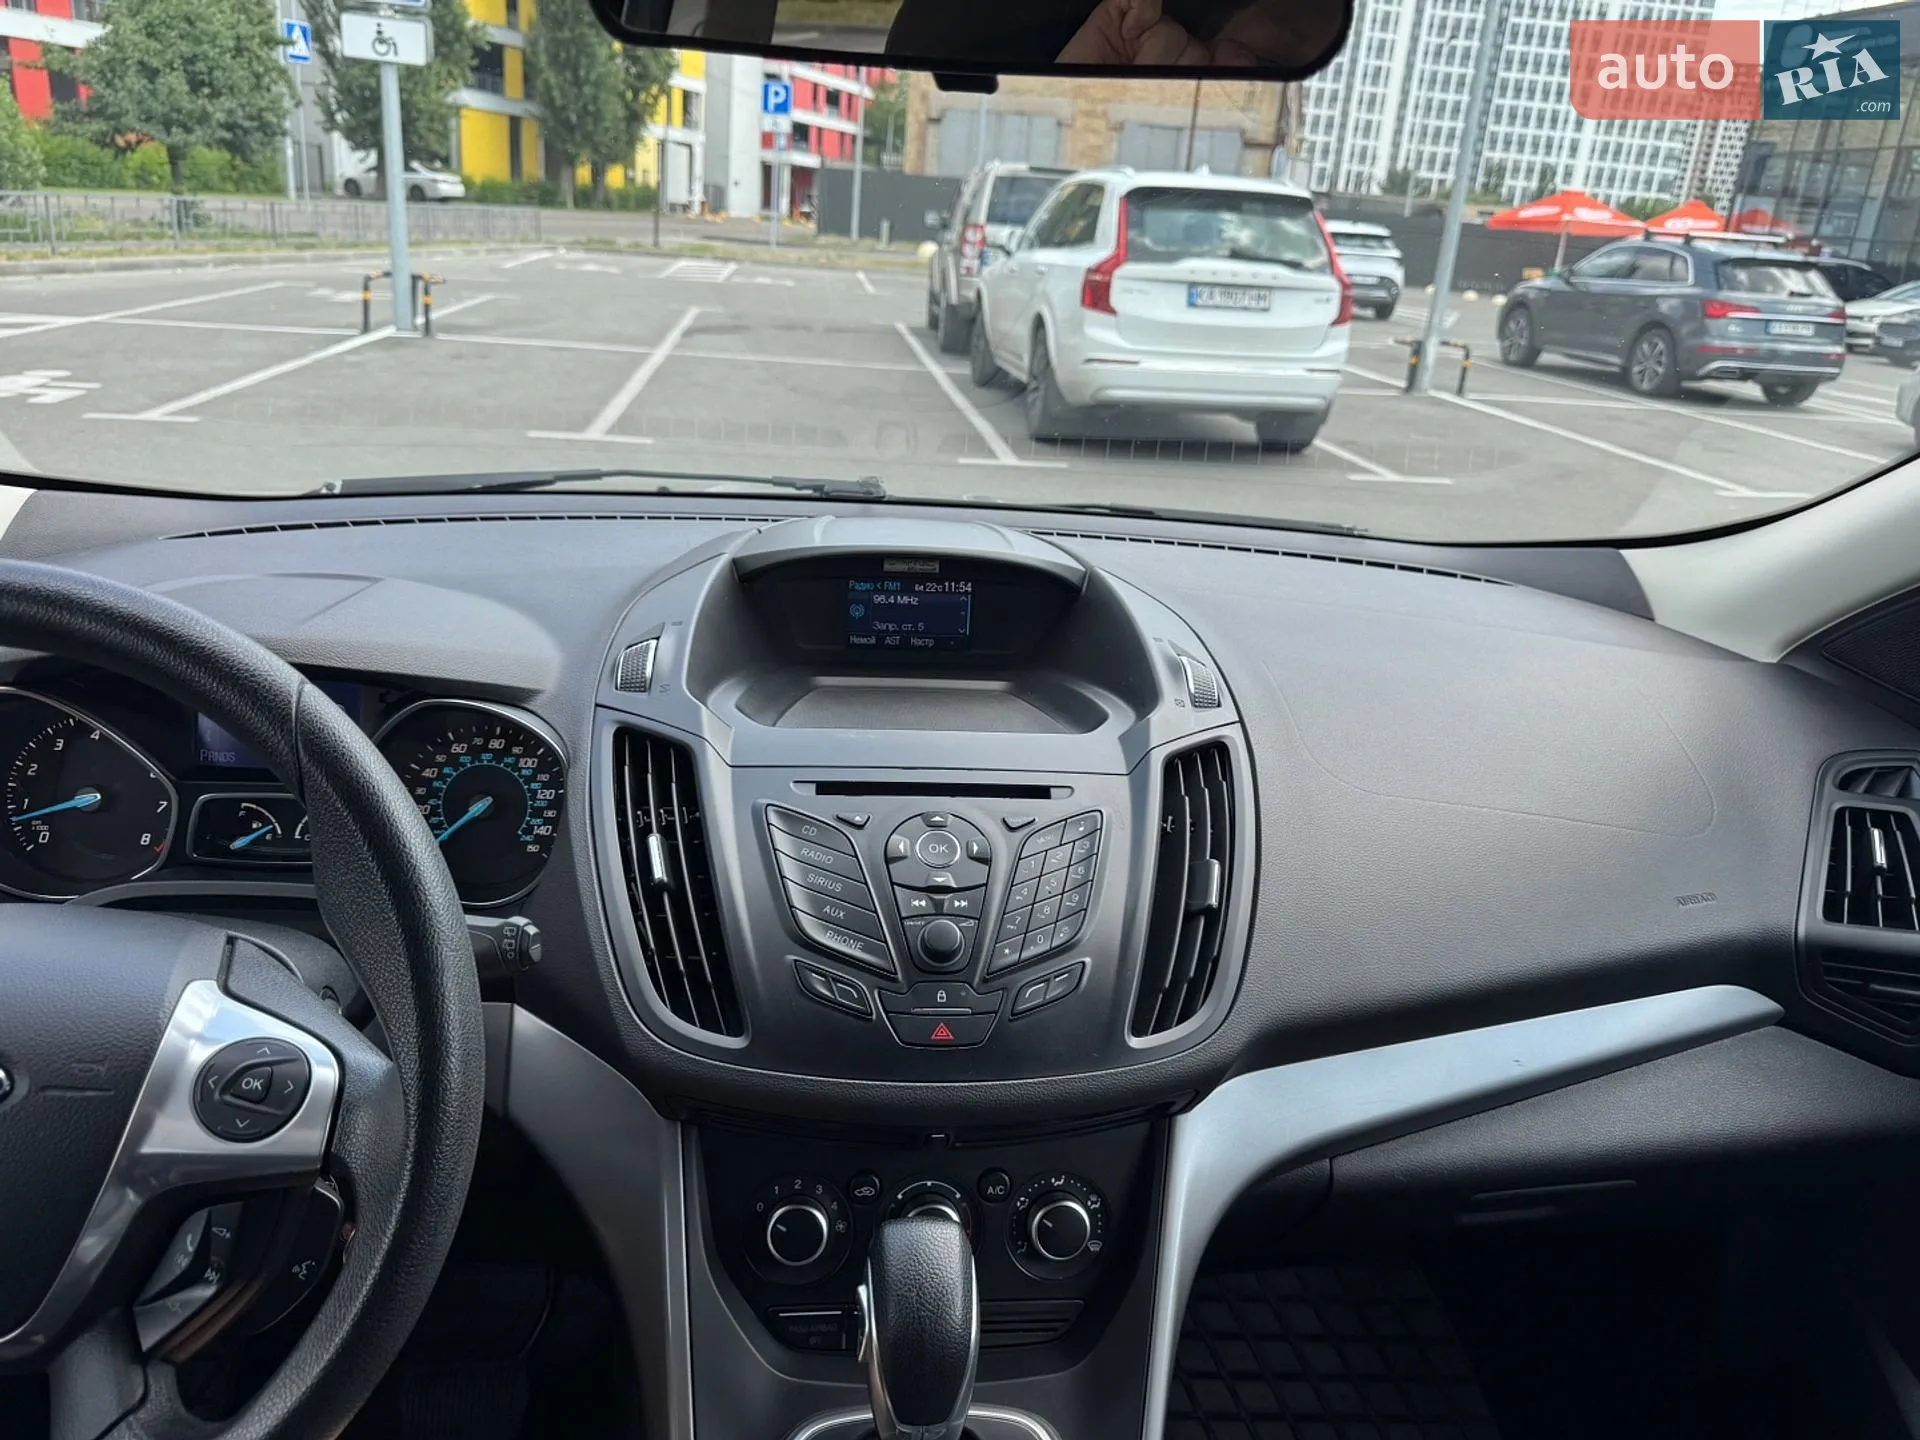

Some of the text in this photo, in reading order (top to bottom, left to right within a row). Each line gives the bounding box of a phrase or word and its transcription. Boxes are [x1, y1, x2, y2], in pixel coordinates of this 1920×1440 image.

[767, 85, 787, 113] P
[883, 581, 901, 591] FM1
[943, 581, 973, 593] 11:54
[872, 594, 920, 606] 96.4 MHz
[884, 635, 902, 646] AST
[89, 729, 101, 740] 4
[53, 738, 64, 751] 3
[450, 743, 468, 754] 60
[488, 738, 506, 750] 80
[434, 754, 447, 763] 50
[518, 757, 538, 769] 100
[27, 763, 38, 777] 2
[421, 767, 438, 778] 40
[535, 789, 555, 800] 120
[22, 798, 30, 811] 1
[156, 800, 169, 814] 7
[532, 825, 552, 836] 140
[801, 825, 818, 837] CD
[38, 831, 50, 844] 0
[139, 832, 151, 846] 8
[928, 843, 950, 854] OK
[800, 847, 835, 865] RADIO
[1030, 860, 1036, 869] 1
[806, 873, 845, 893] SIRIUS
[822, 905, 847, 920] AUX
[1014, 915, 1022, 925] 7
[825, 930, 865, 954] PHONE
[1036, 934, 1045, 945] 0
[241, 1077, 265, 1091] OK
[773, 1185, 780, 1195] 1
[793, 1178, 803, 1190] 2
[815, 1183, 824, 1195] 3
[986, 1185, 1006, 1196] A/C
[756, 1201, 765, 1213] 0
